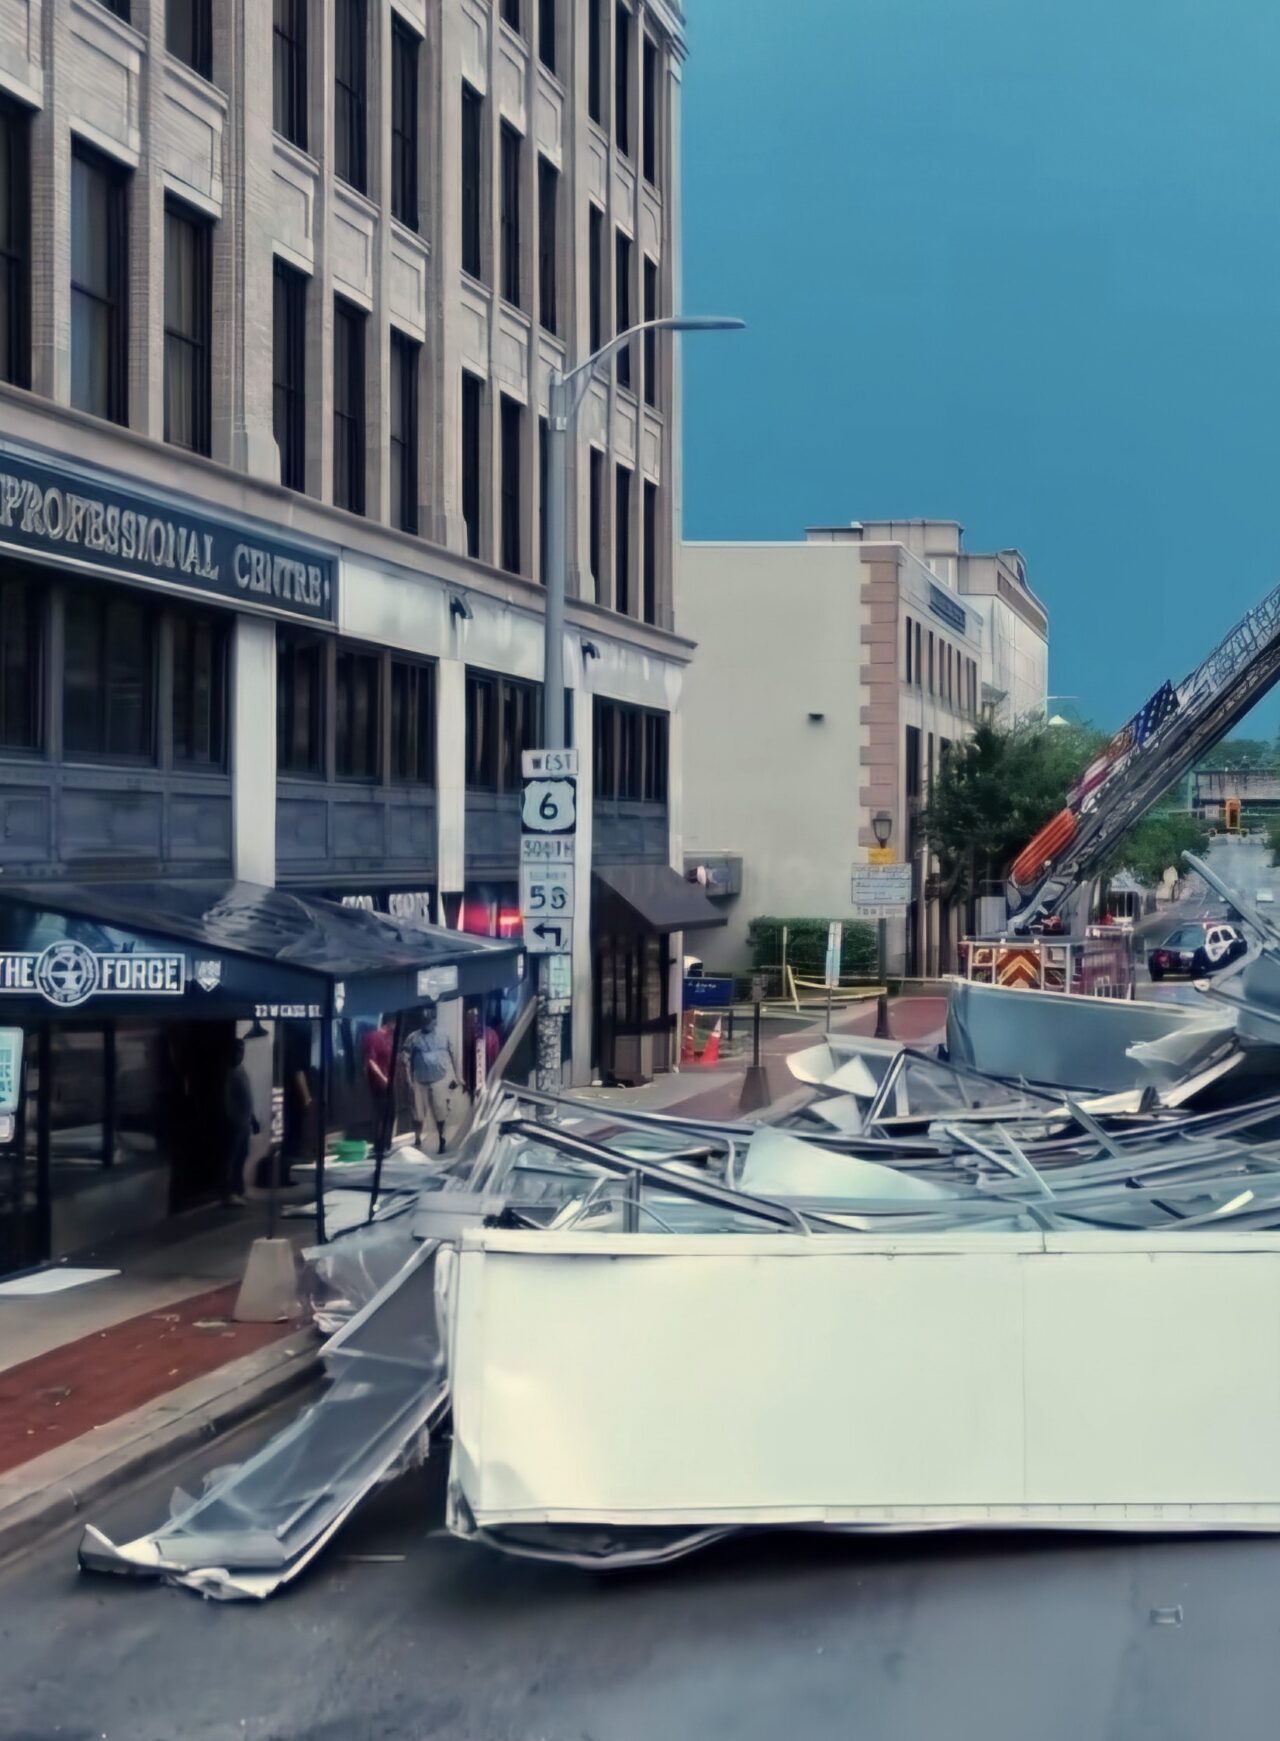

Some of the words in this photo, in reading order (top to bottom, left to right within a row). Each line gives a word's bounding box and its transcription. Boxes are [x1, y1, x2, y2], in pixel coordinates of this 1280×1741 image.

[0, 473, 219, 580] PROFESSIONAL
[539, 792, 558, 820] 6
[102, 958, 178, 990] FORGE
